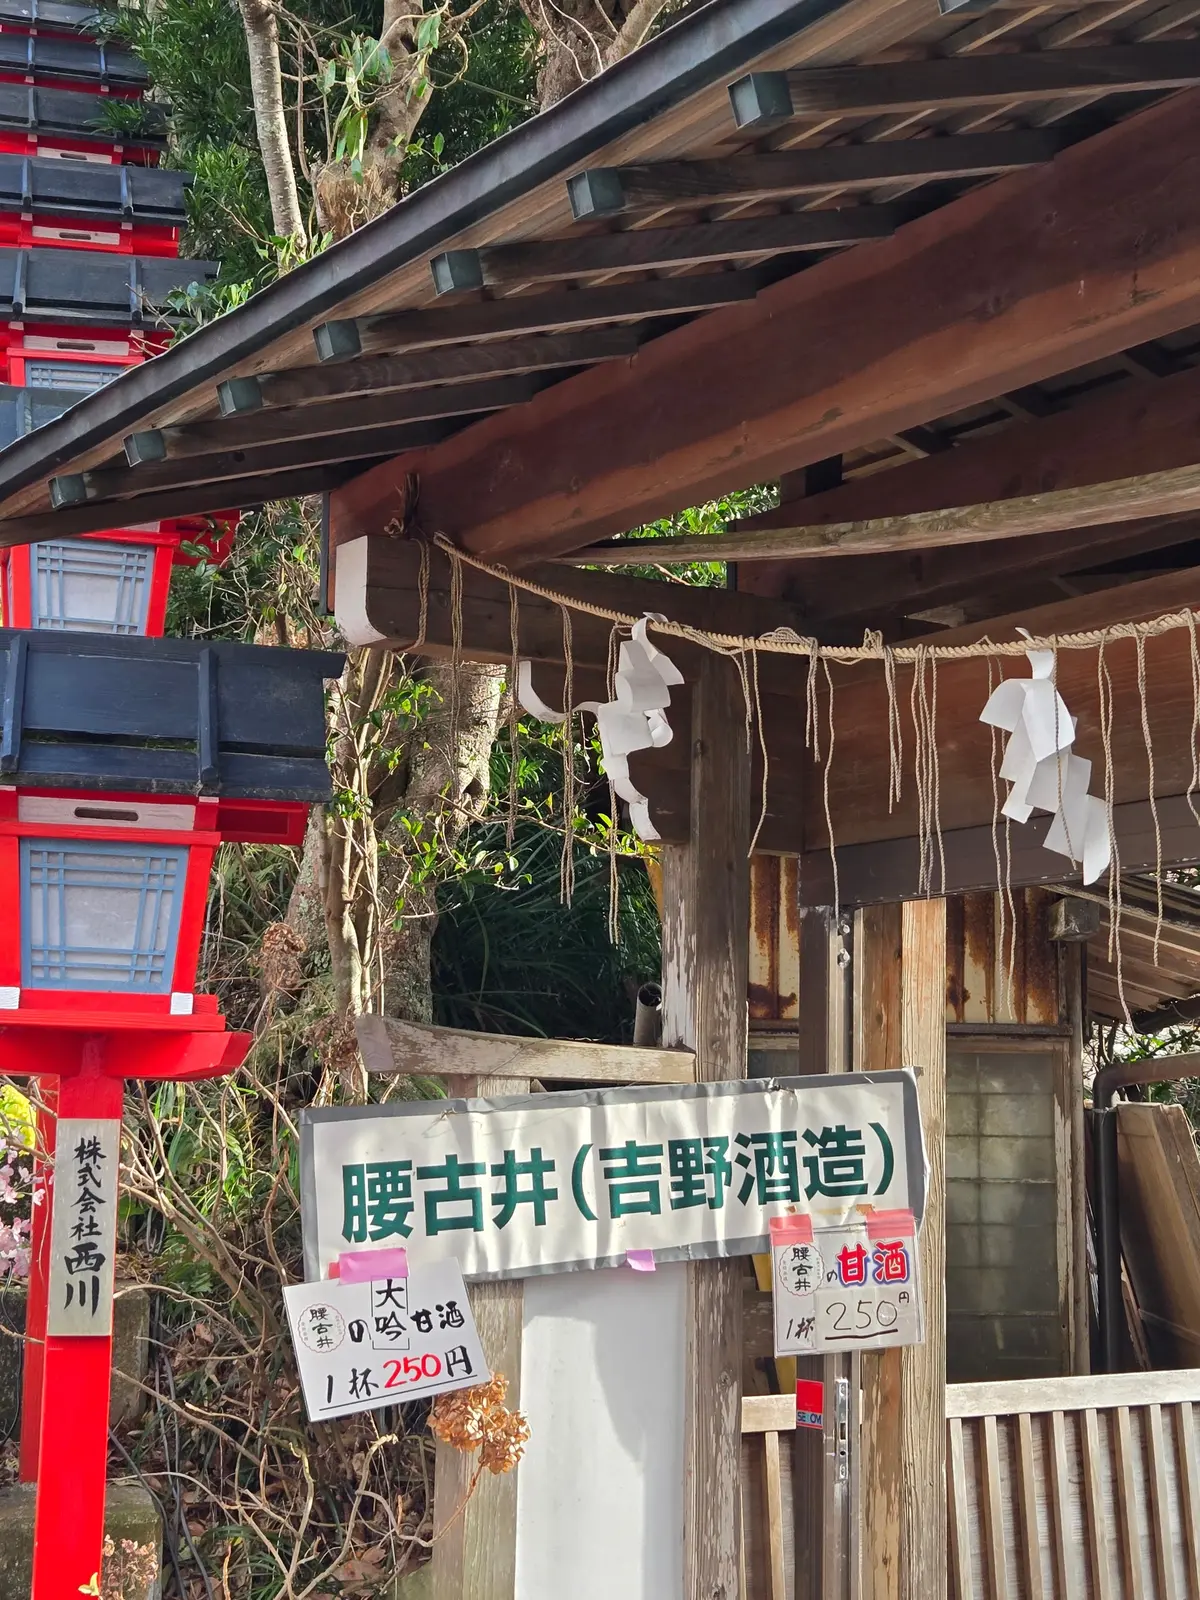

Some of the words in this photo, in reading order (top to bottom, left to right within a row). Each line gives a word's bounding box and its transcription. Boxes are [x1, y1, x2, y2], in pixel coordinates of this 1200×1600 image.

[64, 1136, 106, 1317] 株式会社西川
[792, 1247, 813, 1291] 腰古井
[309, 1308, 334, 1348] 腰古井
